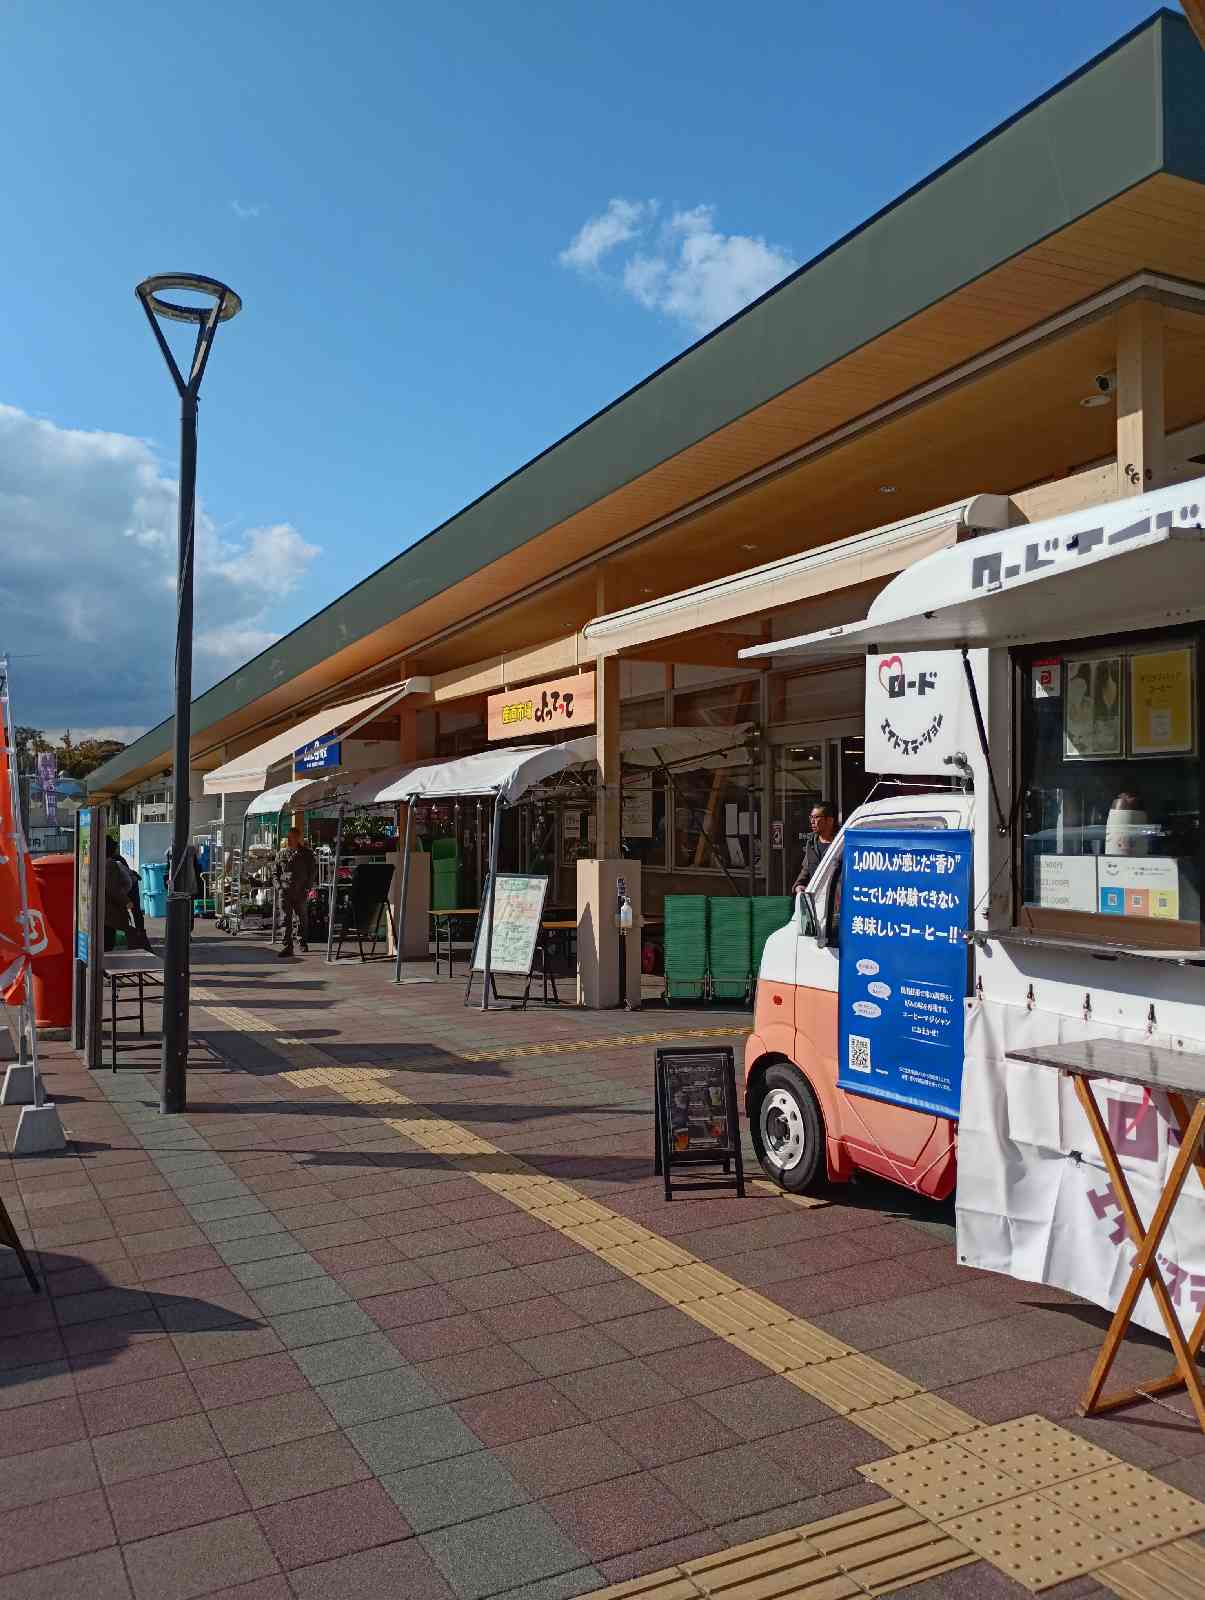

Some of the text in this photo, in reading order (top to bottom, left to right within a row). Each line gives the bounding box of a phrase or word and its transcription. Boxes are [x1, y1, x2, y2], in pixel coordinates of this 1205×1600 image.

[888, 671, 938, 698] ロード
[502, 700, 532, 724] 産直市場
[881, 712, 943, 756] エイドステーション
[852, 886, 960, 909] ここでしか体験できない
